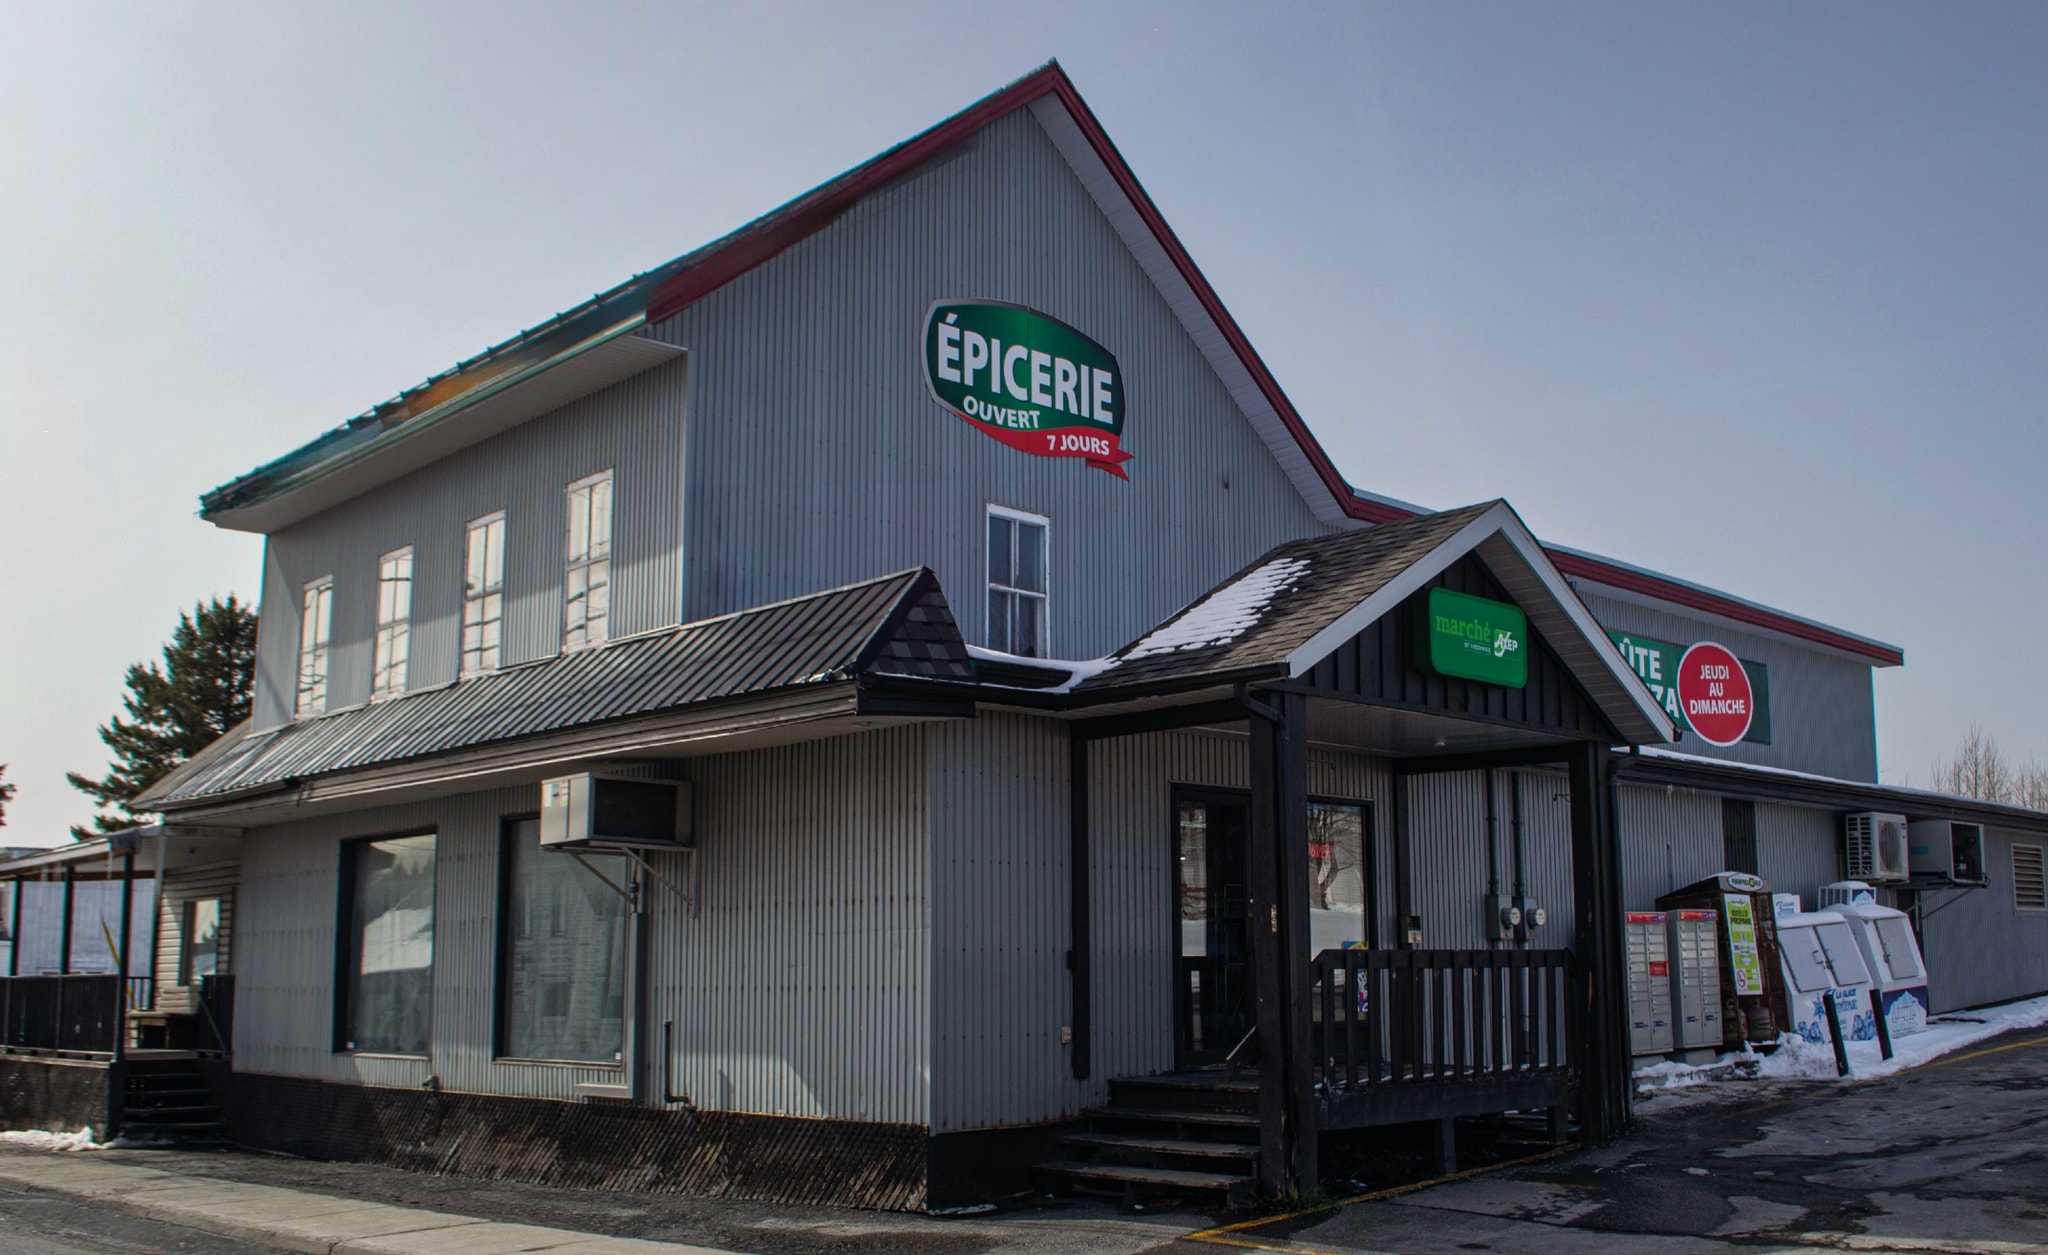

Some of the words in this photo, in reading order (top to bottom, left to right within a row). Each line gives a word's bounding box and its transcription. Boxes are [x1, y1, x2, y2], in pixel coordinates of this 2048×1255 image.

[938, 312, 1113, 425] ÉPICERIE
[963, 396, 1040, 429] OUVERT
[1047, 435, 1056, 451] 7
[1060, 435, 1110, 456] JOURS
[1436, 615, 1490, 642] marché
[1700, 665, 1729, 680] JEUDI
[1709, 682, 1724, 697] AU
[1690, 699, 1745, 715] DIMANCHE
